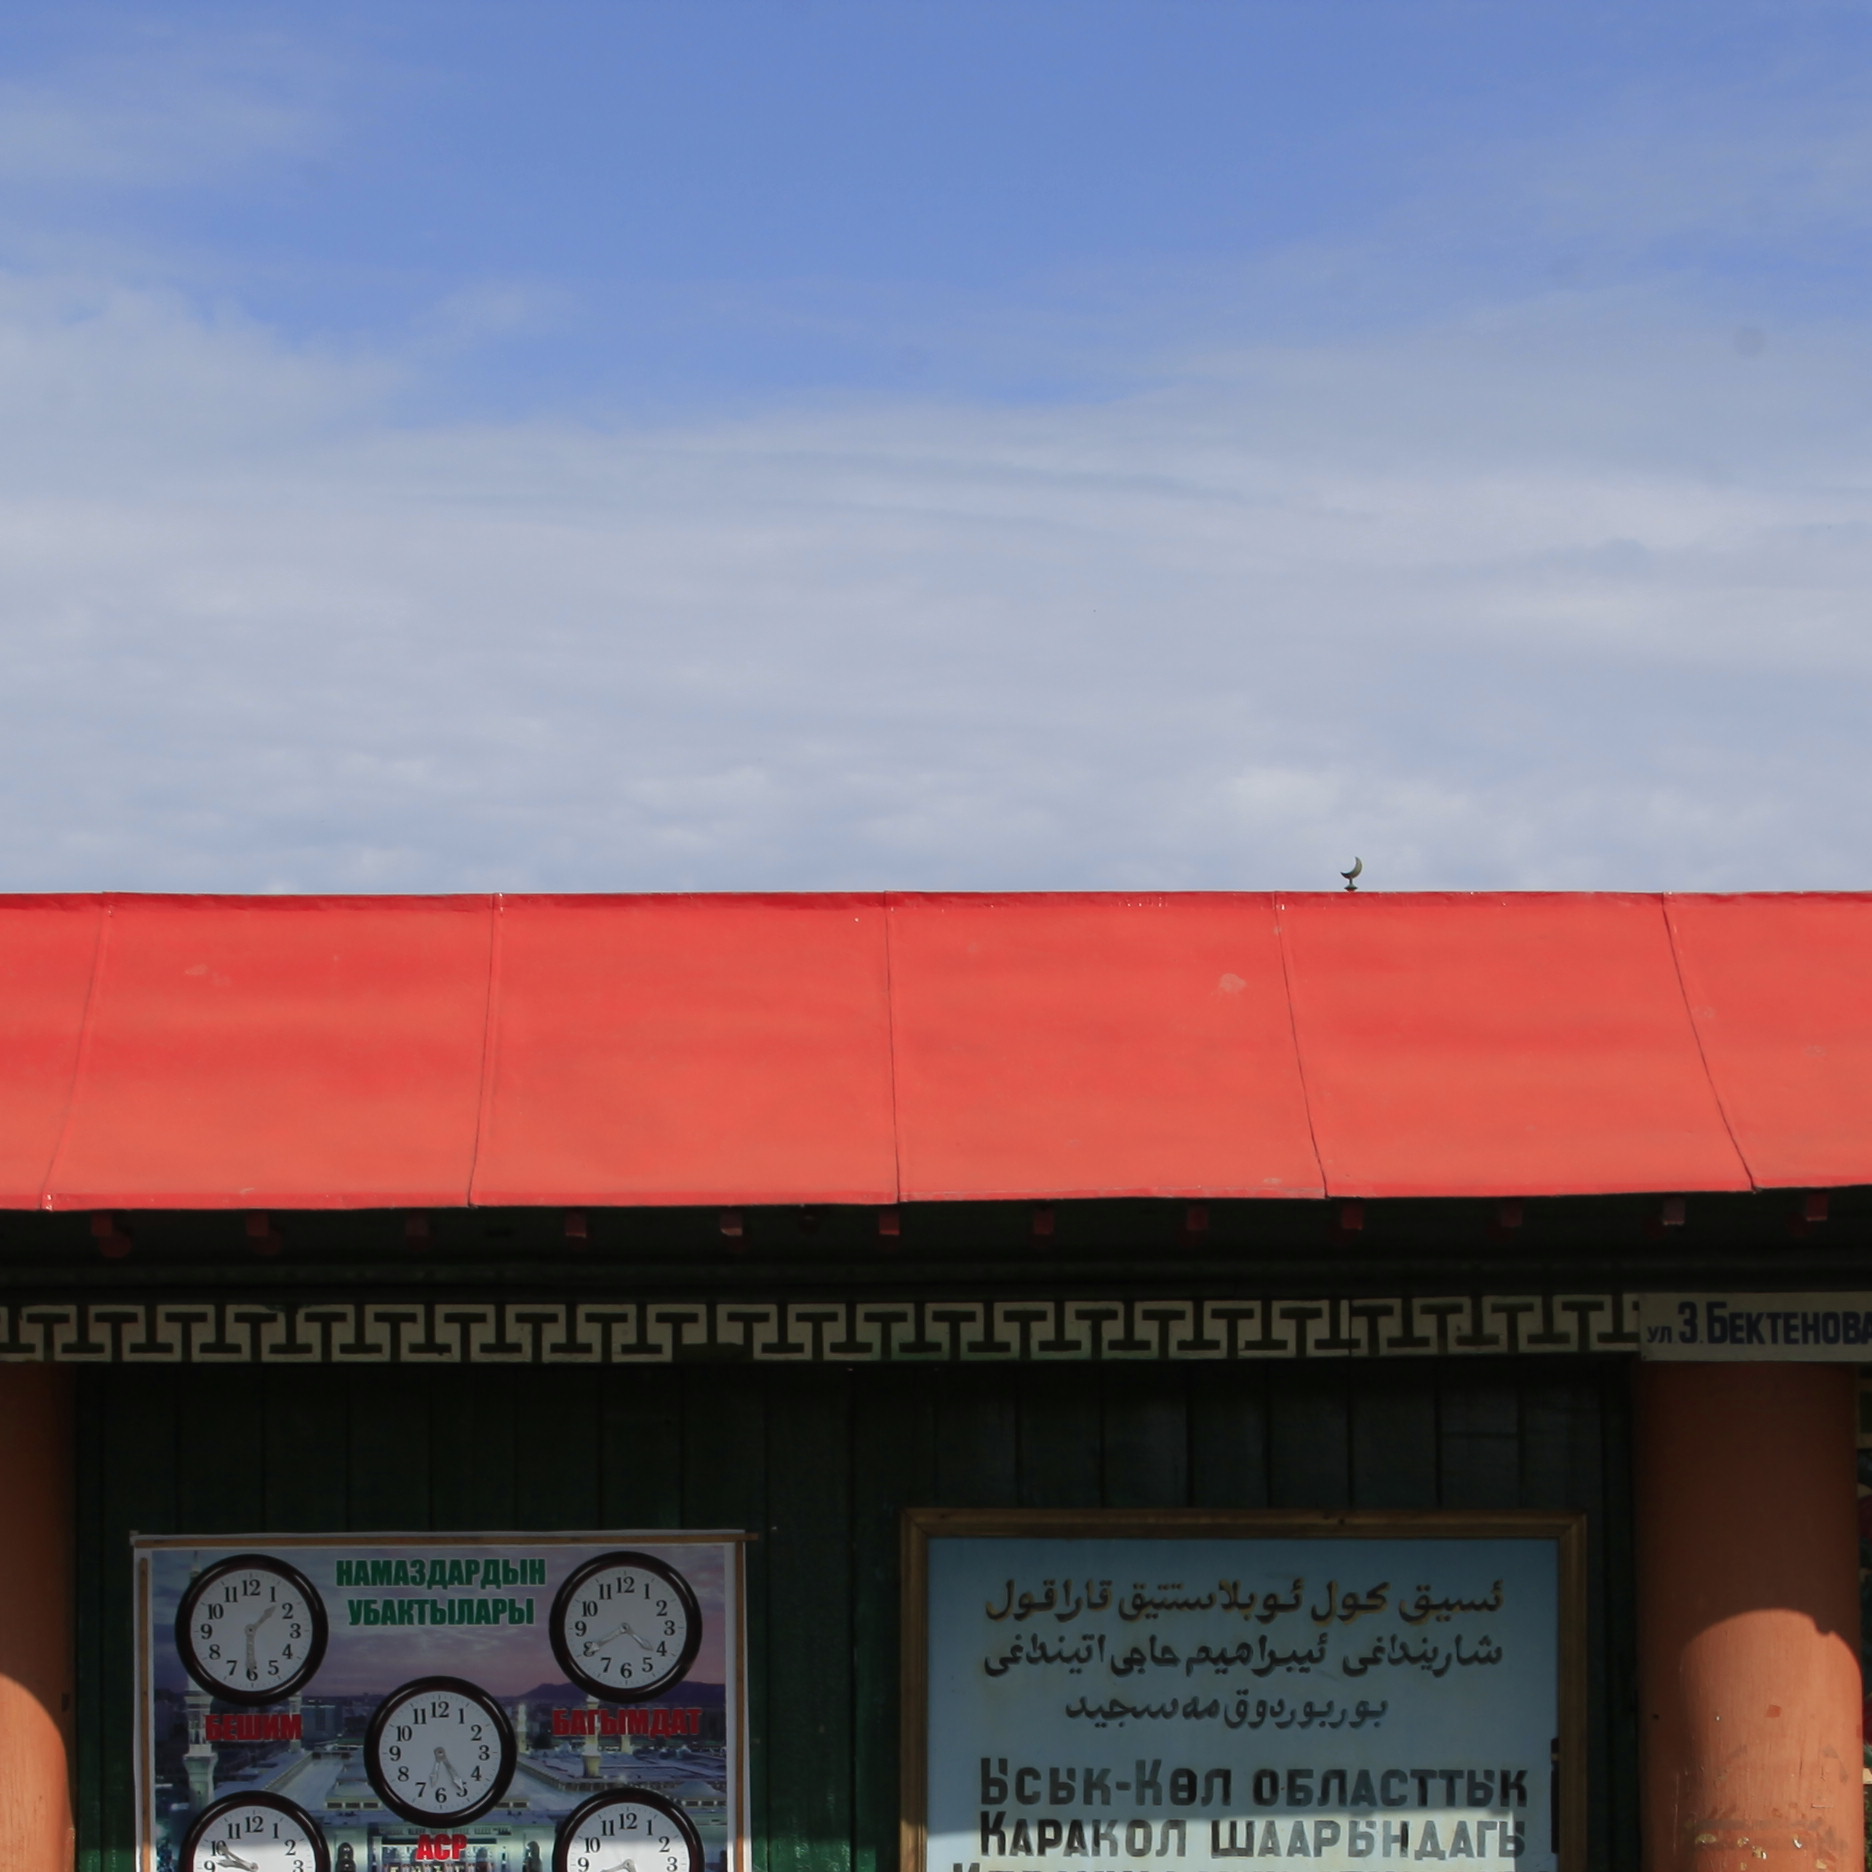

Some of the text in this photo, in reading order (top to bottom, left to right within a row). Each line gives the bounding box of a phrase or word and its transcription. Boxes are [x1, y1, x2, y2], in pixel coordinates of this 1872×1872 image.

[336, 1558, 546, 1590] НАМАЗДАРДЫН
[242, 1579, 260, 1596] 12
[599, 1583, 612, 1600] 11
[616, 1576, 635, 1593] 12
[644, 1583, 650, 1600] 1
[225, 1586, 238, 1603] 11
[270, 1586, 276, 1603] 1
[208, 1603, 224, 1620] 10
[282, 1603, 294, 1619] 2
[347, 1598, 534, 1626] УБАКТЫЛАРЫ
[582, 1600, 598, 1617] 10
[656, 1600, 668, 1617] 2
[200, 1624, 213, 1640] 9
[289, 1623, 301, 1639] 3
[575, 1621, 587, 1637] 9
[664, 1620, 676, 1636] 3
[209, 1644, 221, 1660] 8
[282, 1643, 293, 1660] 4
[656, 1641, 668, 1657] 4
[226, 1660, 238, 1676] 7
[267, 1660, 279, 1676] 5
[601, 1657, 612, 1673] 7
[620, 1662, 633, 1678] 6
[642, 1657, 653, 1673] 5
[413, 1708, 427, 1725] 11
[431, 1701, 449, 1718] 12
[459, 1708, 465, 1724] 1
[205, 1714, 303, 1741] БЕШИМ
[552, 1708, 702, 1738] БАГЫМДАТ
[396, 1725, 413, 1742] 10
[471, 1725, 482, 1741] 2
[389, 1746, 402, 1761] 9
[478, 1745, 490, 1761] 3
[398, 1766, 410, 1782] 8
[471, 1765, 482, 1782] 4
[415, 1782, 426, 1798] 7
[435, 1787, 447, 1803] 6
[245, 1816, 263, 1833] 12
[601, 1820, 615, 1836] 11
[619, 1813, 637, 1830] 12
[647, 1820, 653, 1836] 1
[228, 1823, 241, 1839] 11
[273, 1823, 279, 1839] 1
[285, 1839, 297, 1856] 2
[416, 1834, 469, 1862] АСР
[584, 1837, 601, 1853] 10
[659, 1836, 670, 1853] 2
[577, 1857, 590, 1872] 9
[666, 1856, 678, 1872] 3
